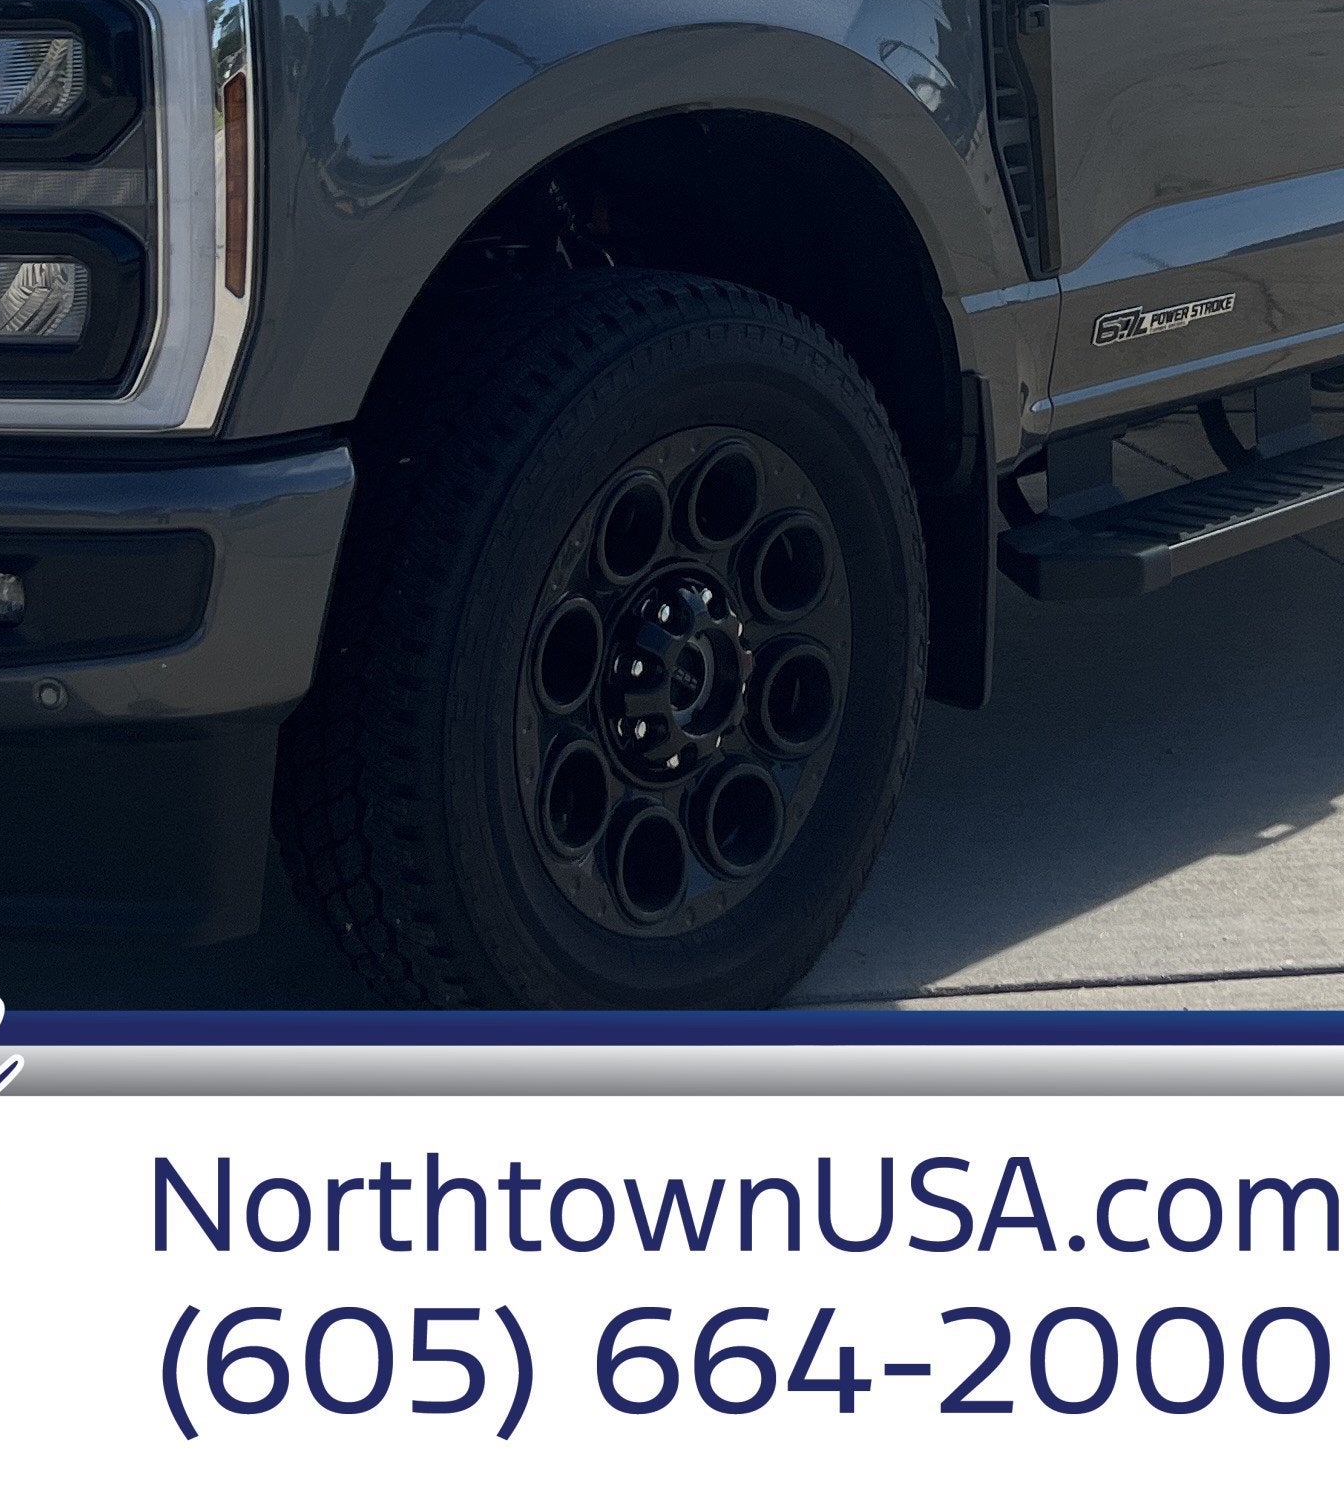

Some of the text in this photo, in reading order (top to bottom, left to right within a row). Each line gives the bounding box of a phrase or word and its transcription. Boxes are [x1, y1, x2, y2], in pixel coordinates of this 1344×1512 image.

[1092, 306, 1147, 346] 6.7L
[1150, 306, 1189, 327] POWER
[1191, 297, 1233, 318] STROKE
